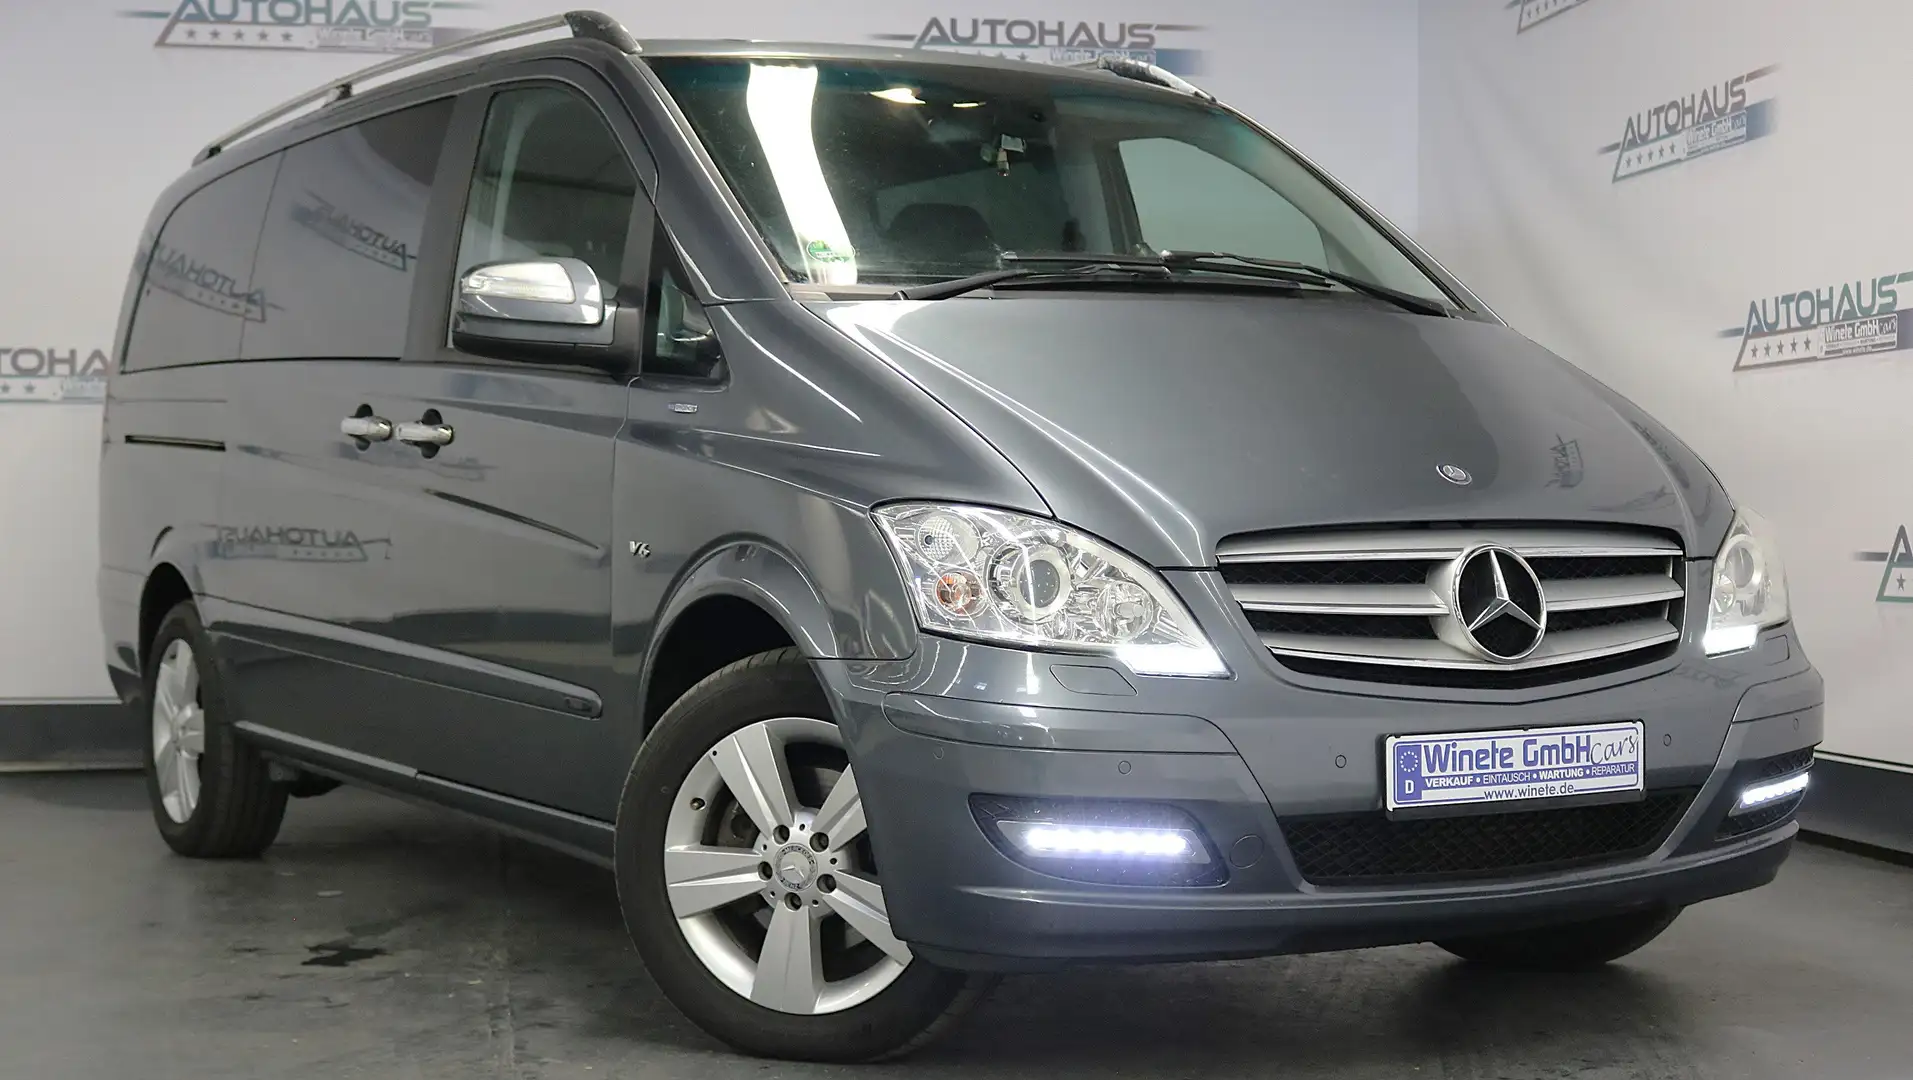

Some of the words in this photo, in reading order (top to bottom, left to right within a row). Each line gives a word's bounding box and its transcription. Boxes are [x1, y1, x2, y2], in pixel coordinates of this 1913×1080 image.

[174, 0, 432, 27] AUTOHAUS
[916, 16, 1156, 49] AUTOHAUS
[1623, 75, 1747, 149] AUTOHAUS
[1746, 275, 1898, 335] AUTOHAUS
[1854, 319, 1879, 338] GmbH
[629, 540, 651, 559] V6
[1423, 740, 1514, 774] Winete
[1522, 734, 1592, 768] GmbH
[1590, 733, 1638, 765] Cars
[1404, 779, 1415, 795] D
[1425, 776, 1474, 788] VERKAUF
[1482, 771, 1531, 785] EINTAUSCH
[1539, 768, 1584, 781] WARTUNG
[1591, 763, 1635, 776] REPARATUR
[1484, 783, 1575, 801] www.winete.de
